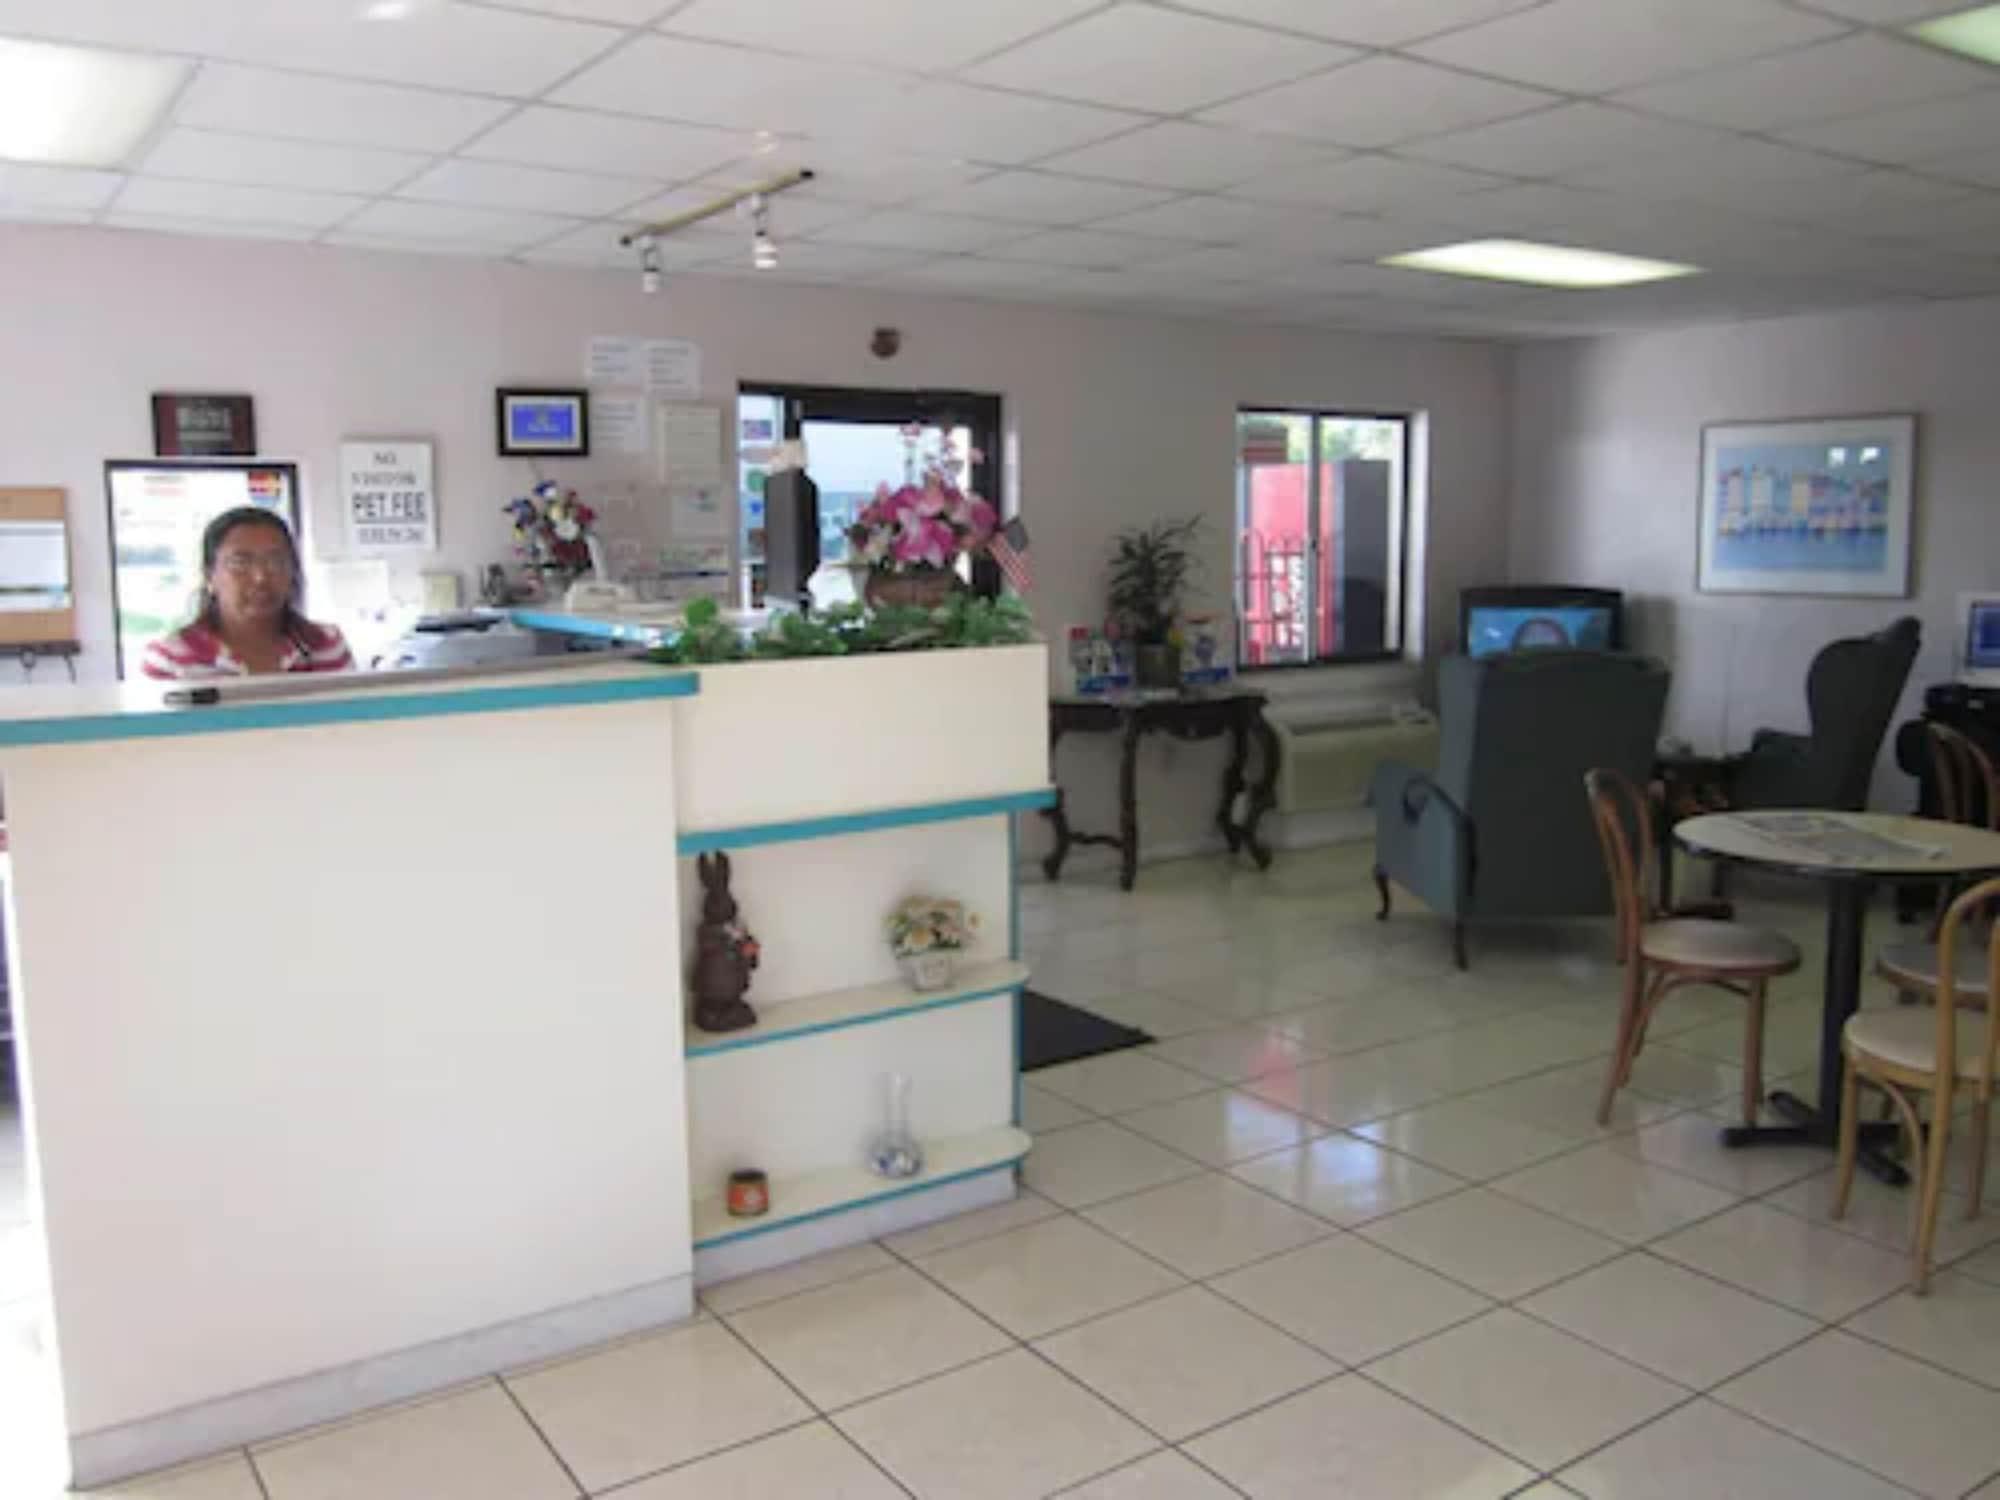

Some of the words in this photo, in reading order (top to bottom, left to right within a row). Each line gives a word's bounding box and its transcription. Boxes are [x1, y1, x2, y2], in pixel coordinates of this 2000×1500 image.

[374, 450, 398, 466] NO
[352, 491, 385, 517] PET
[391, 491, 426, 518] FEE
